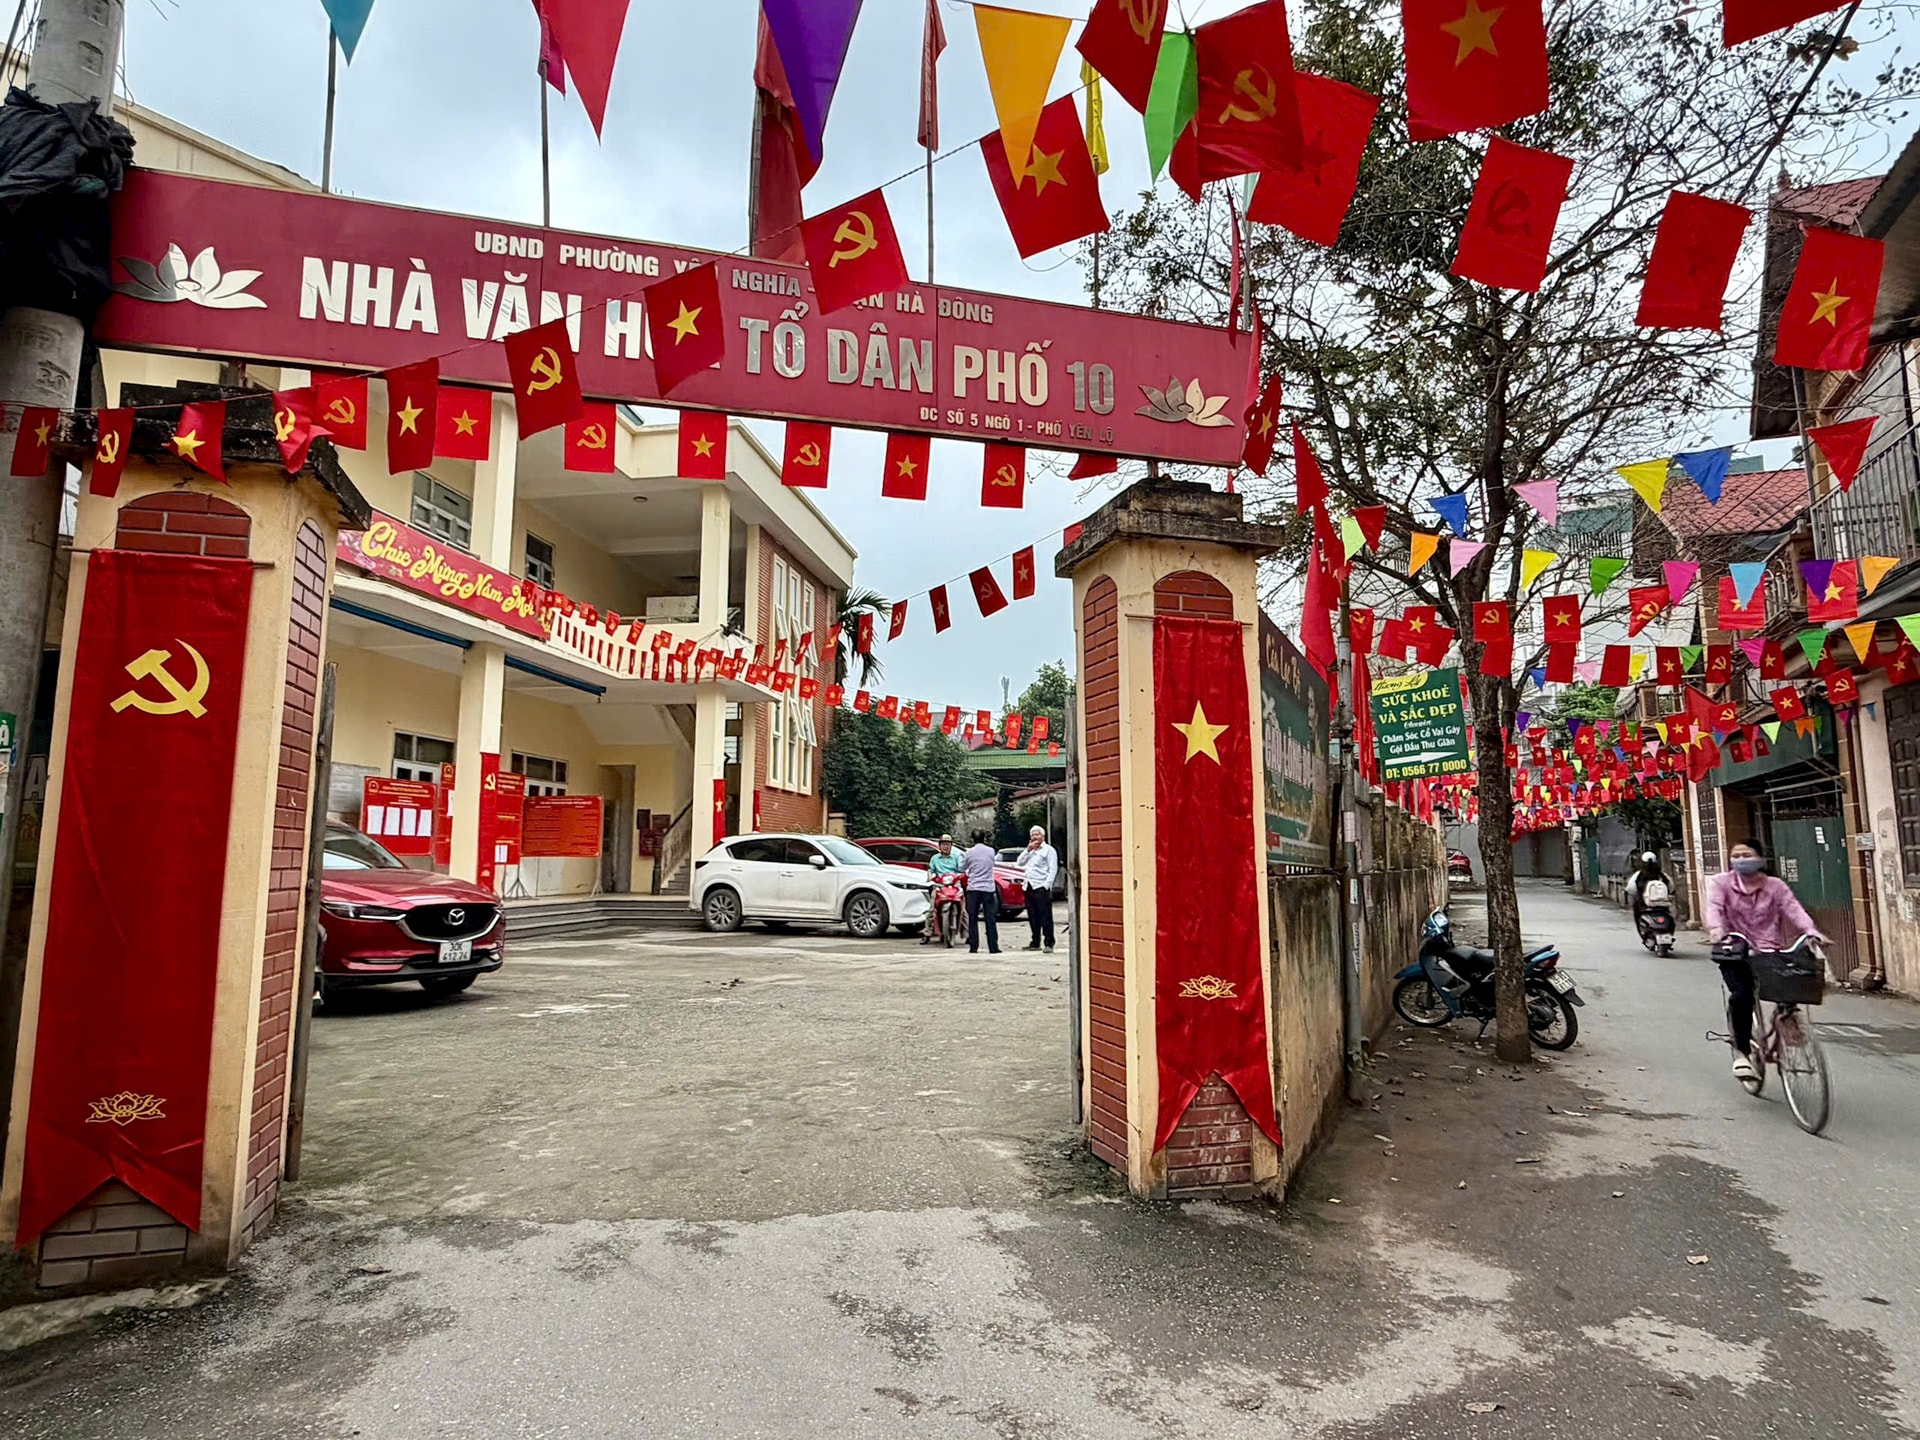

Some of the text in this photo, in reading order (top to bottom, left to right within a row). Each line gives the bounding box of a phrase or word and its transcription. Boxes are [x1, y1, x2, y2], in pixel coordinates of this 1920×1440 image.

[474, 231, 544, 259] UBND
[559, 244, 659, 277] PHƯỜNG
[731, 268, 801, 298] NGHĨA
[896, 290, 925, 314] HÀ
[937, 296, 993, 324] ĐÔNG
[298, 256, 440, 334] NHÀ
[461, 270, 583, 354] VĂN
[739, 301, 808, 379] TỔ
[826, 321, 935, 394] DÂN
[952, 339, 1054, 408] PHỐ
[1065, 359, 1116, 415] 10
[919, 406, 938, 422] ĐC
[946, 407, 965, 425] SỐ
[970, 413, 979, 427] 5
[985, 414, 1011, 431] NGÕ
[1017, 419, 1024, 432] 1
[1036, 419, 1063, 437] PHỐ
[1068, 423, 1092, 440] YÊN
[1378, 702, 1457, 725] VÀ SẮC ĐẸP
[1381, 692, 1408, 708] SỨC
[1427, 762, 1440, 773] 77
[1442, 758, 1467, 772] 0000
